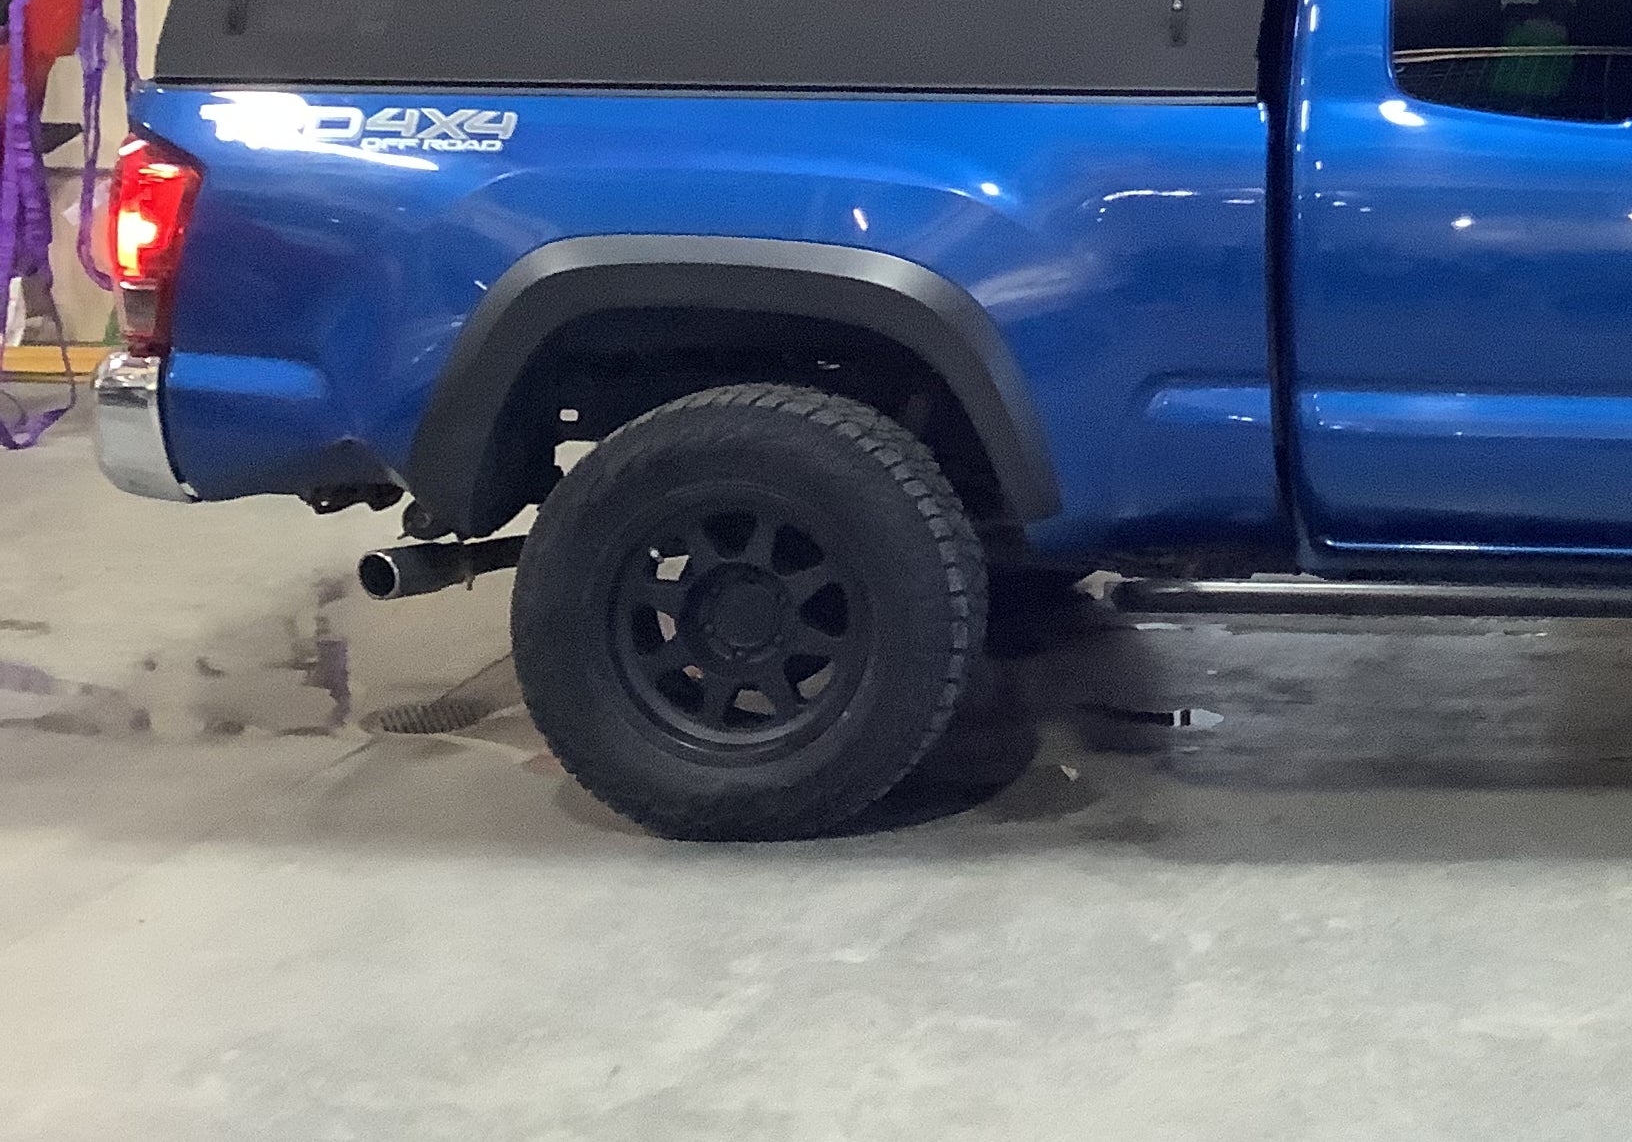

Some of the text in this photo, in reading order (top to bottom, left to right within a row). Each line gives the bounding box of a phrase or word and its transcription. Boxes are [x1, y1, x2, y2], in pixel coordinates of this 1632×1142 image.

[366, 107, 519, 140] 4X4
[360, 137, 504, 152] OFF ROAD
